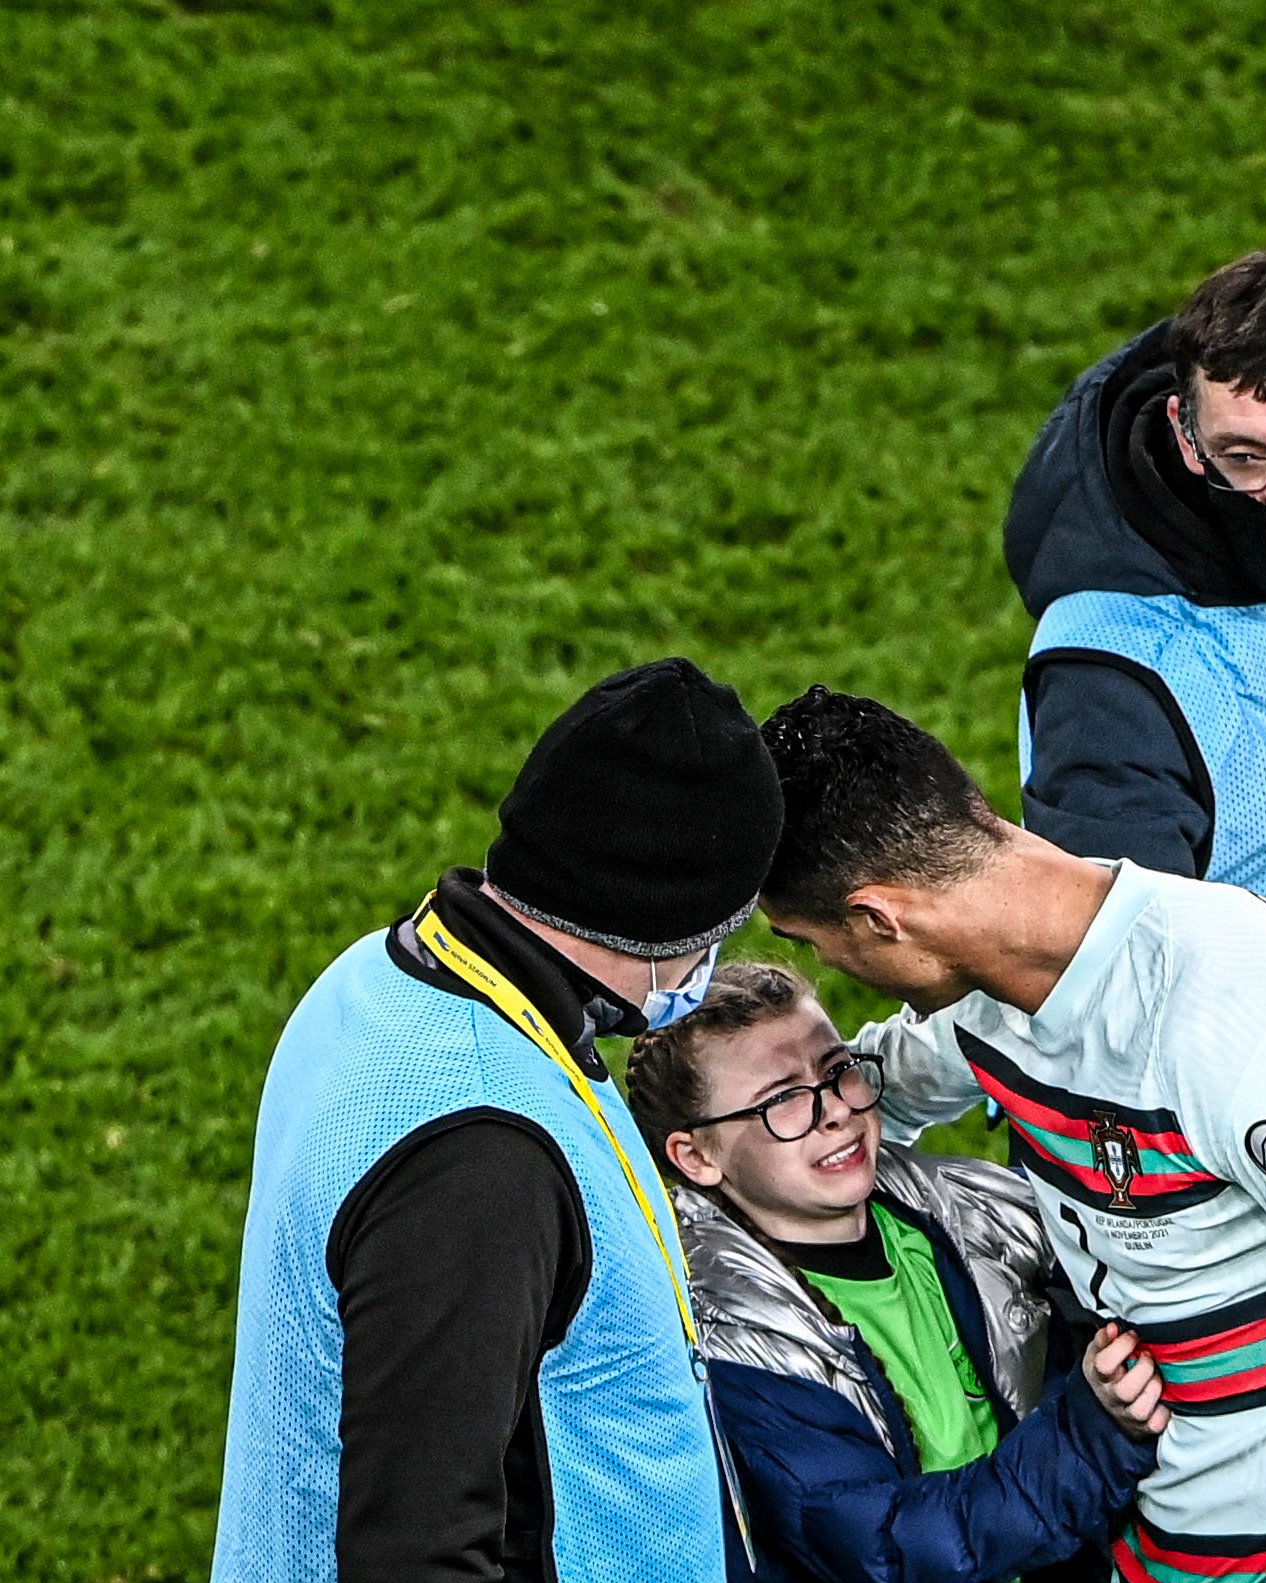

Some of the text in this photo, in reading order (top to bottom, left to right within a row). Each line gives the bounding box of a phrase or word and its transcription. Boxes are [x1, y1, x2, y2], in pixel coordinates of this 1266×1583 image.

[1149, 1228, 1169, 1239] 2021
[1124, 1241, 1154, 1250] DUBLIN
[1060, 1202, 1110, 1311] 7
